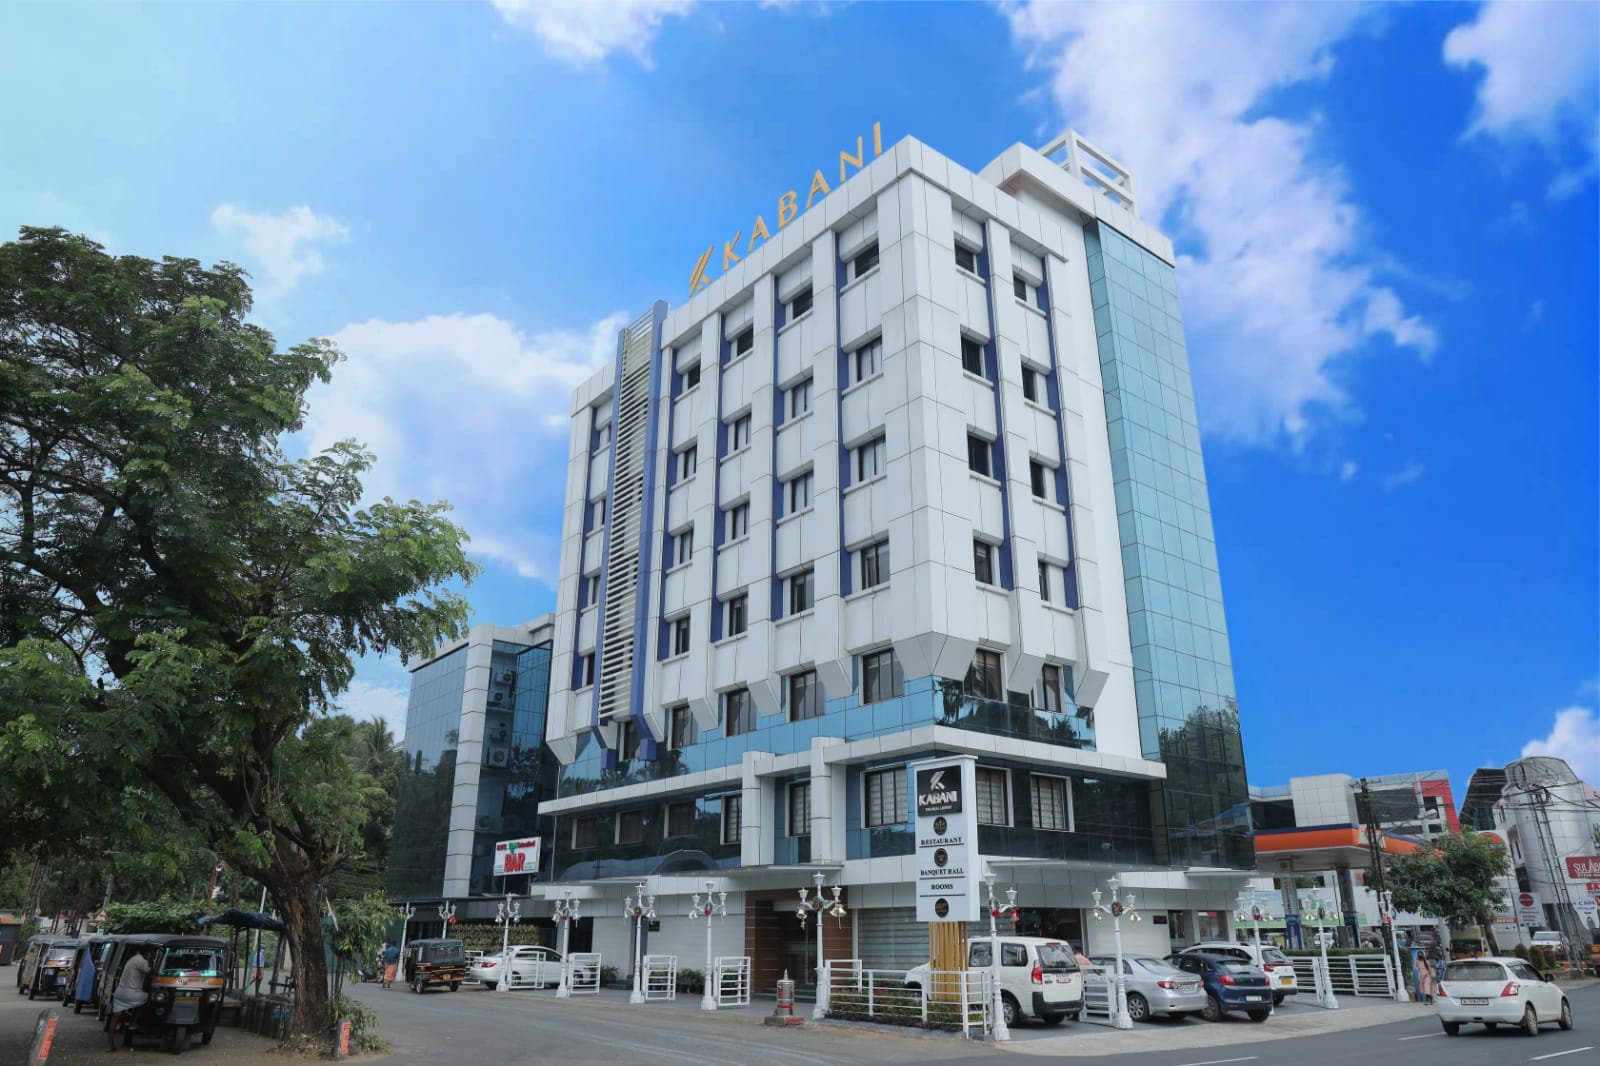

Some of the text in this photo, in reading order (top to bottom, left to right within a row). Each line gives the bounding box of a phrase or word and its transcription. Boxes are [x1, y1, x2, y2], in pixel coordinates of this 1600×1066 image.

[723, 120, 882, 271] KABANI
[919, 791, 957, 805] KABANI
[921, 837, 962, 845] RESTAURANT
[503, 852, 526, 873] BAR
